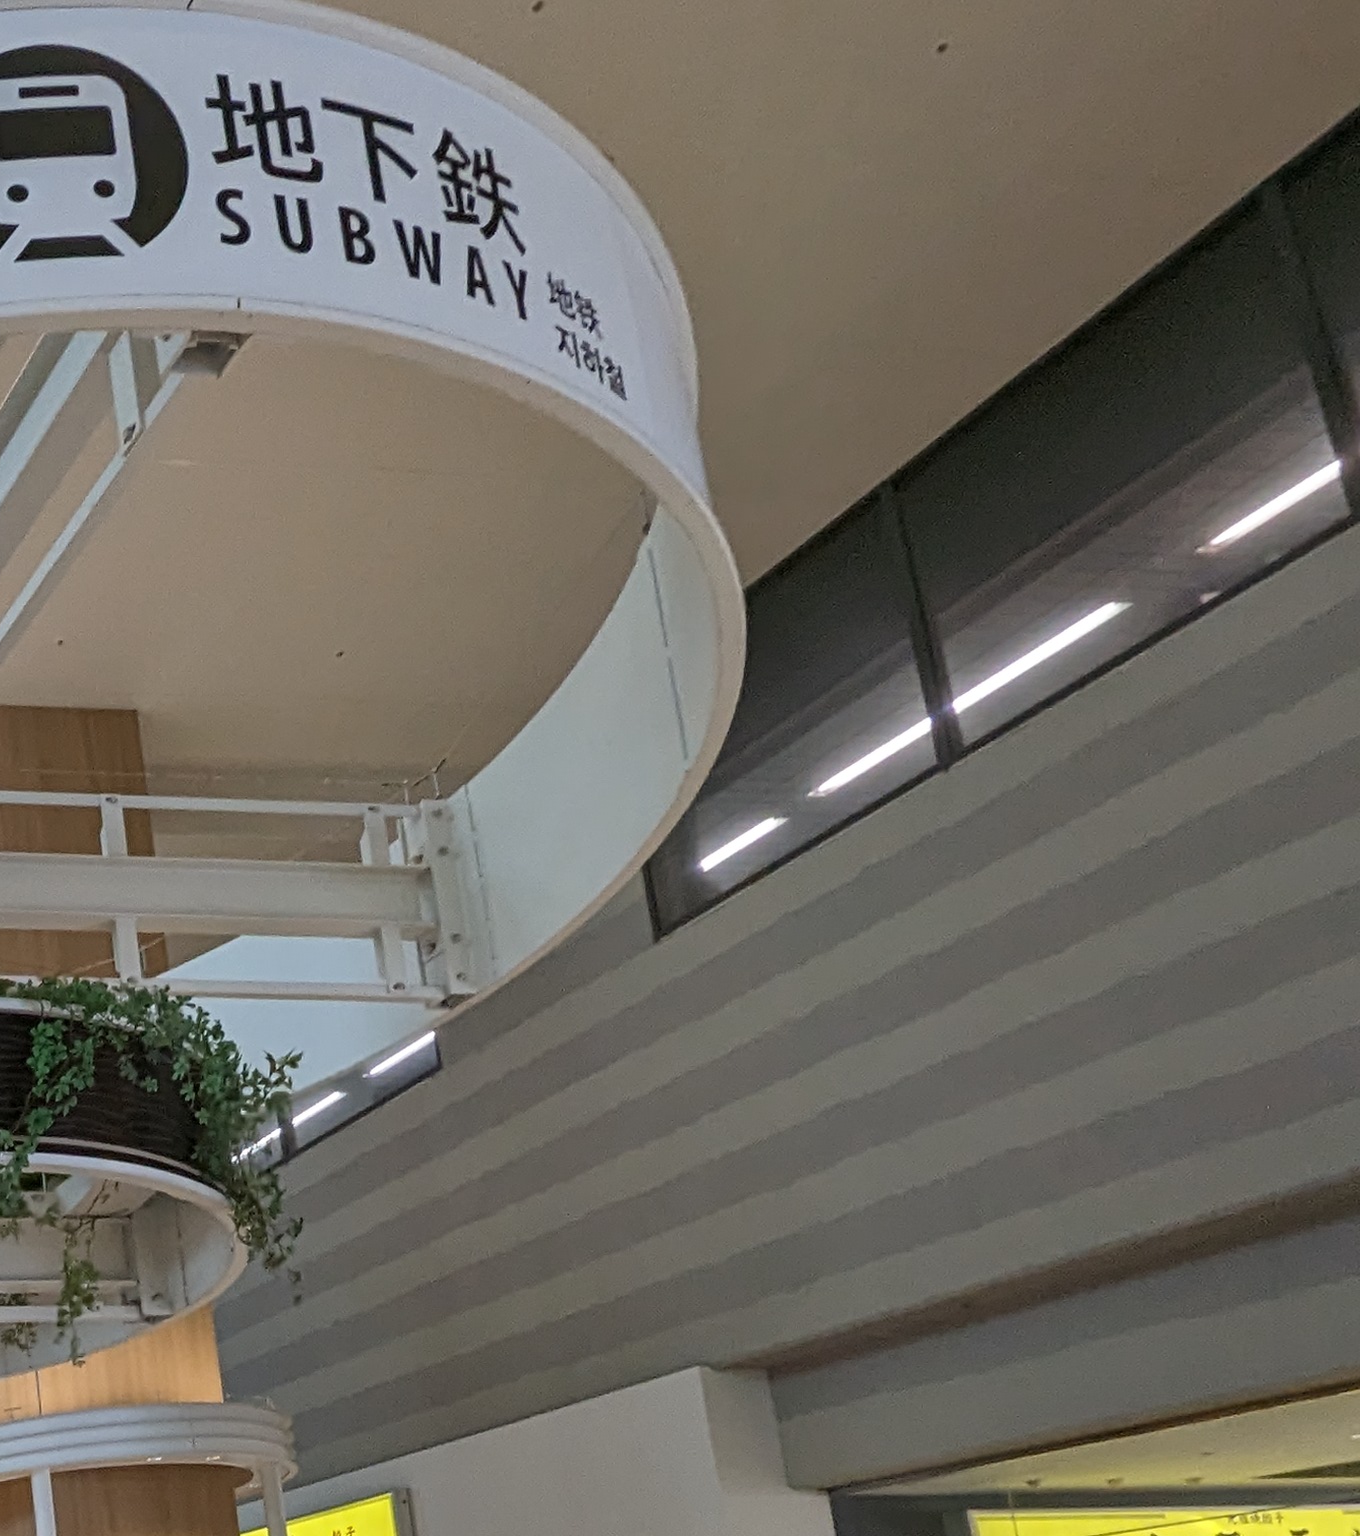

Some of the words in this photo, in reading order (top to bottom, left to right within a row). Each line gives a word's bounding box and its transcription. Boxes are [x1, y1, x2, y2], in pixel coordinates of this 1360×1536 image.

[205, 74, 526, 256] 地下鉄
[215, 188, 529, 321] SUBWAY
[555, 325, 628, 401] 지하철
